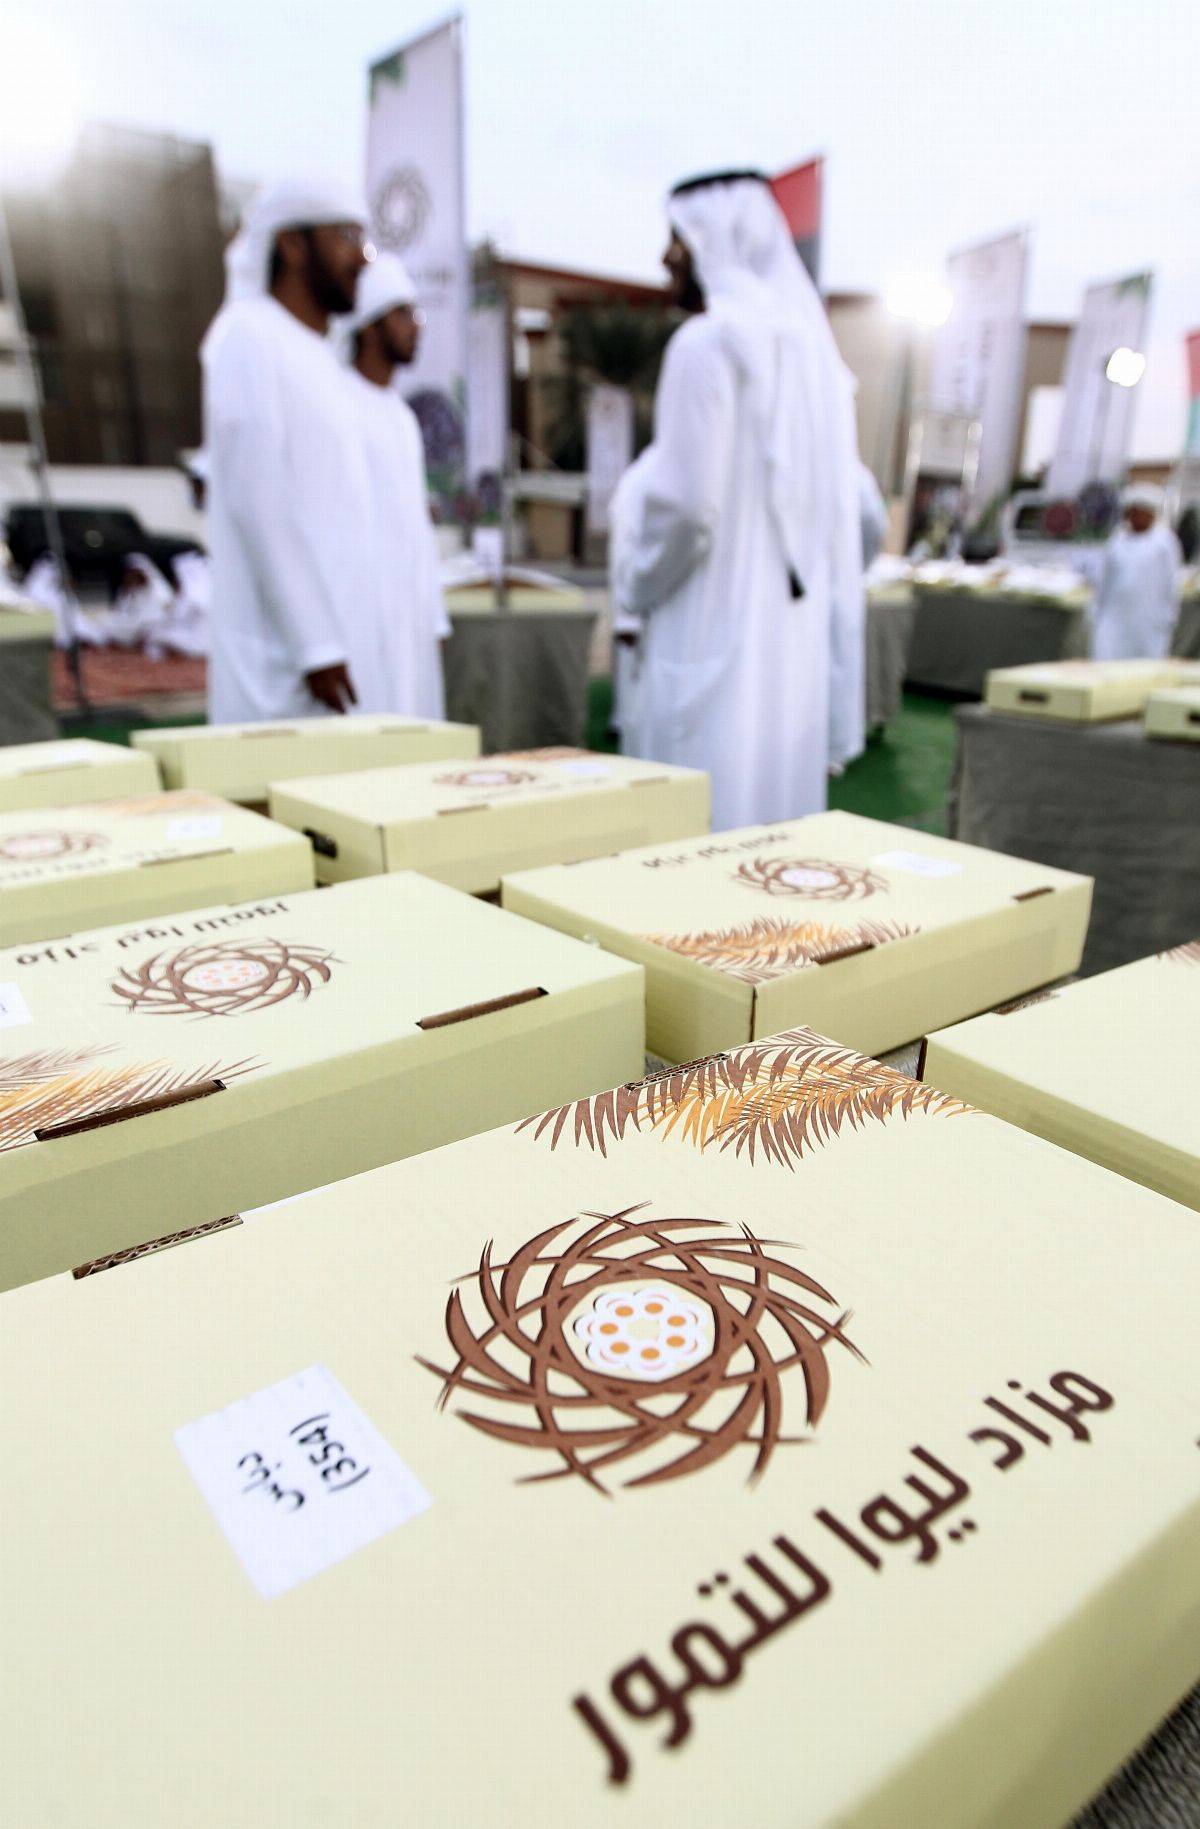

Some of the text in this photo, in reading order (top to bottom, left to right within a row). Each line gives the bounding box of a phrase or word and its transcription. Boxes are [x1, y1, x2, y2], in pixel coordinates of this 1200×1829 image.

[572, 1370, 1115, 1788] مزاد ليوا للتمور
